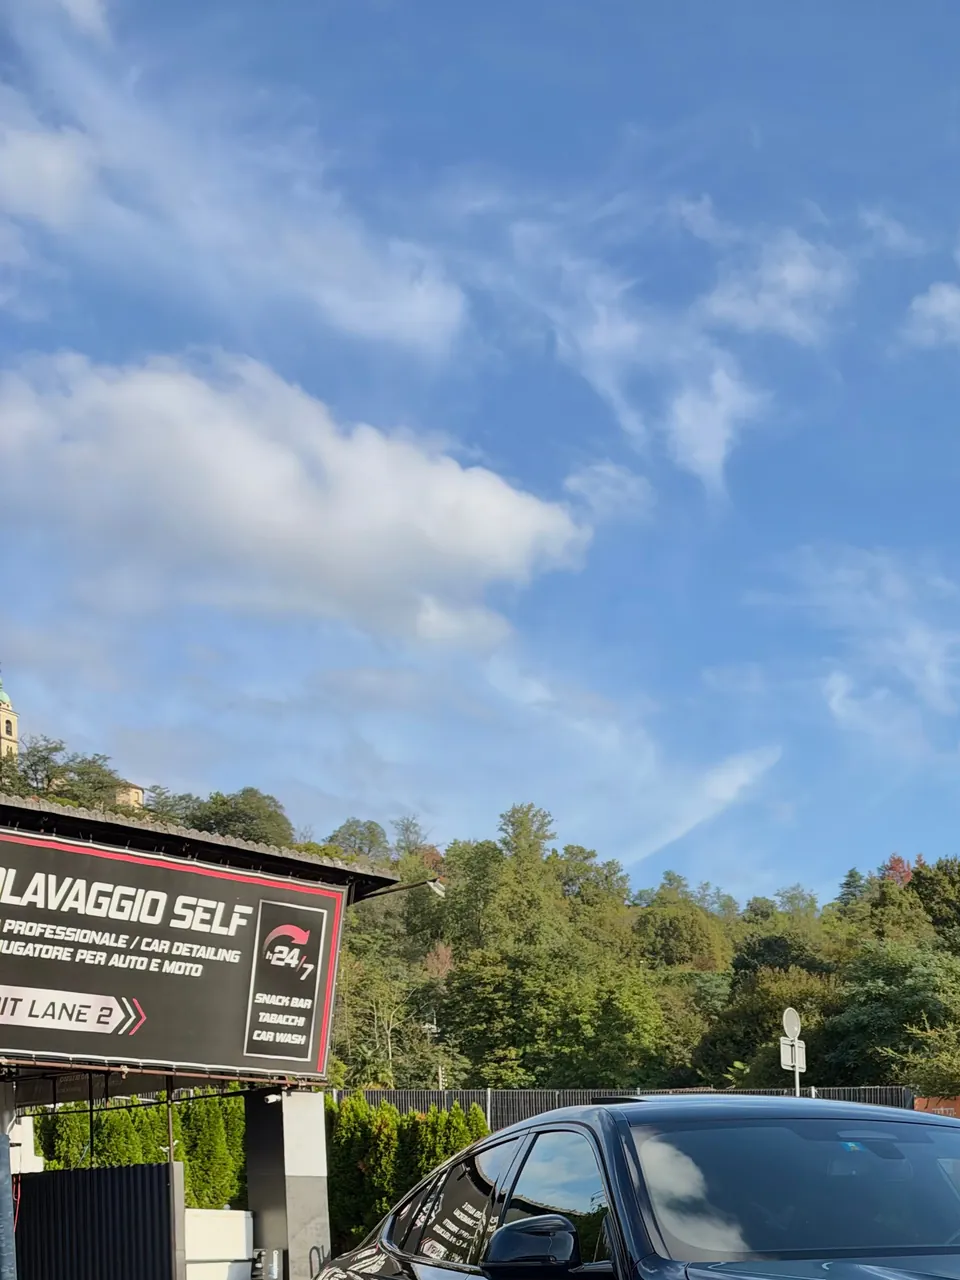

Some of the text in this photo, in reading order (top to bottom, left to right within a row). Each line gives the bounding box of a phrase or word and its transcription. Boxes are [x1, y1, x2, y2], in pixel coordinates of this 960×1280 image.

[0, 867, 254, 936] LAVAGGIO SELF
[2, 919, 129, 948] PROFESSIONALE
[140, 937, 171, 954] CAR
[171, 941, 242, 963] DETAILING
[75, 949, 107, 965] PER
[108, 953, 148, 970] AUTO
[149, 958, 161, 972] E
[162, 959, 203, 977] MOTO
[0, 996, 113, 1025] IT LANE 2
[254, 993, 313, 1009] SNACK BAR
[258, 1012, 306, 1027] TABACCHI
[252, 1030, 307, 1045] CAR WASH
